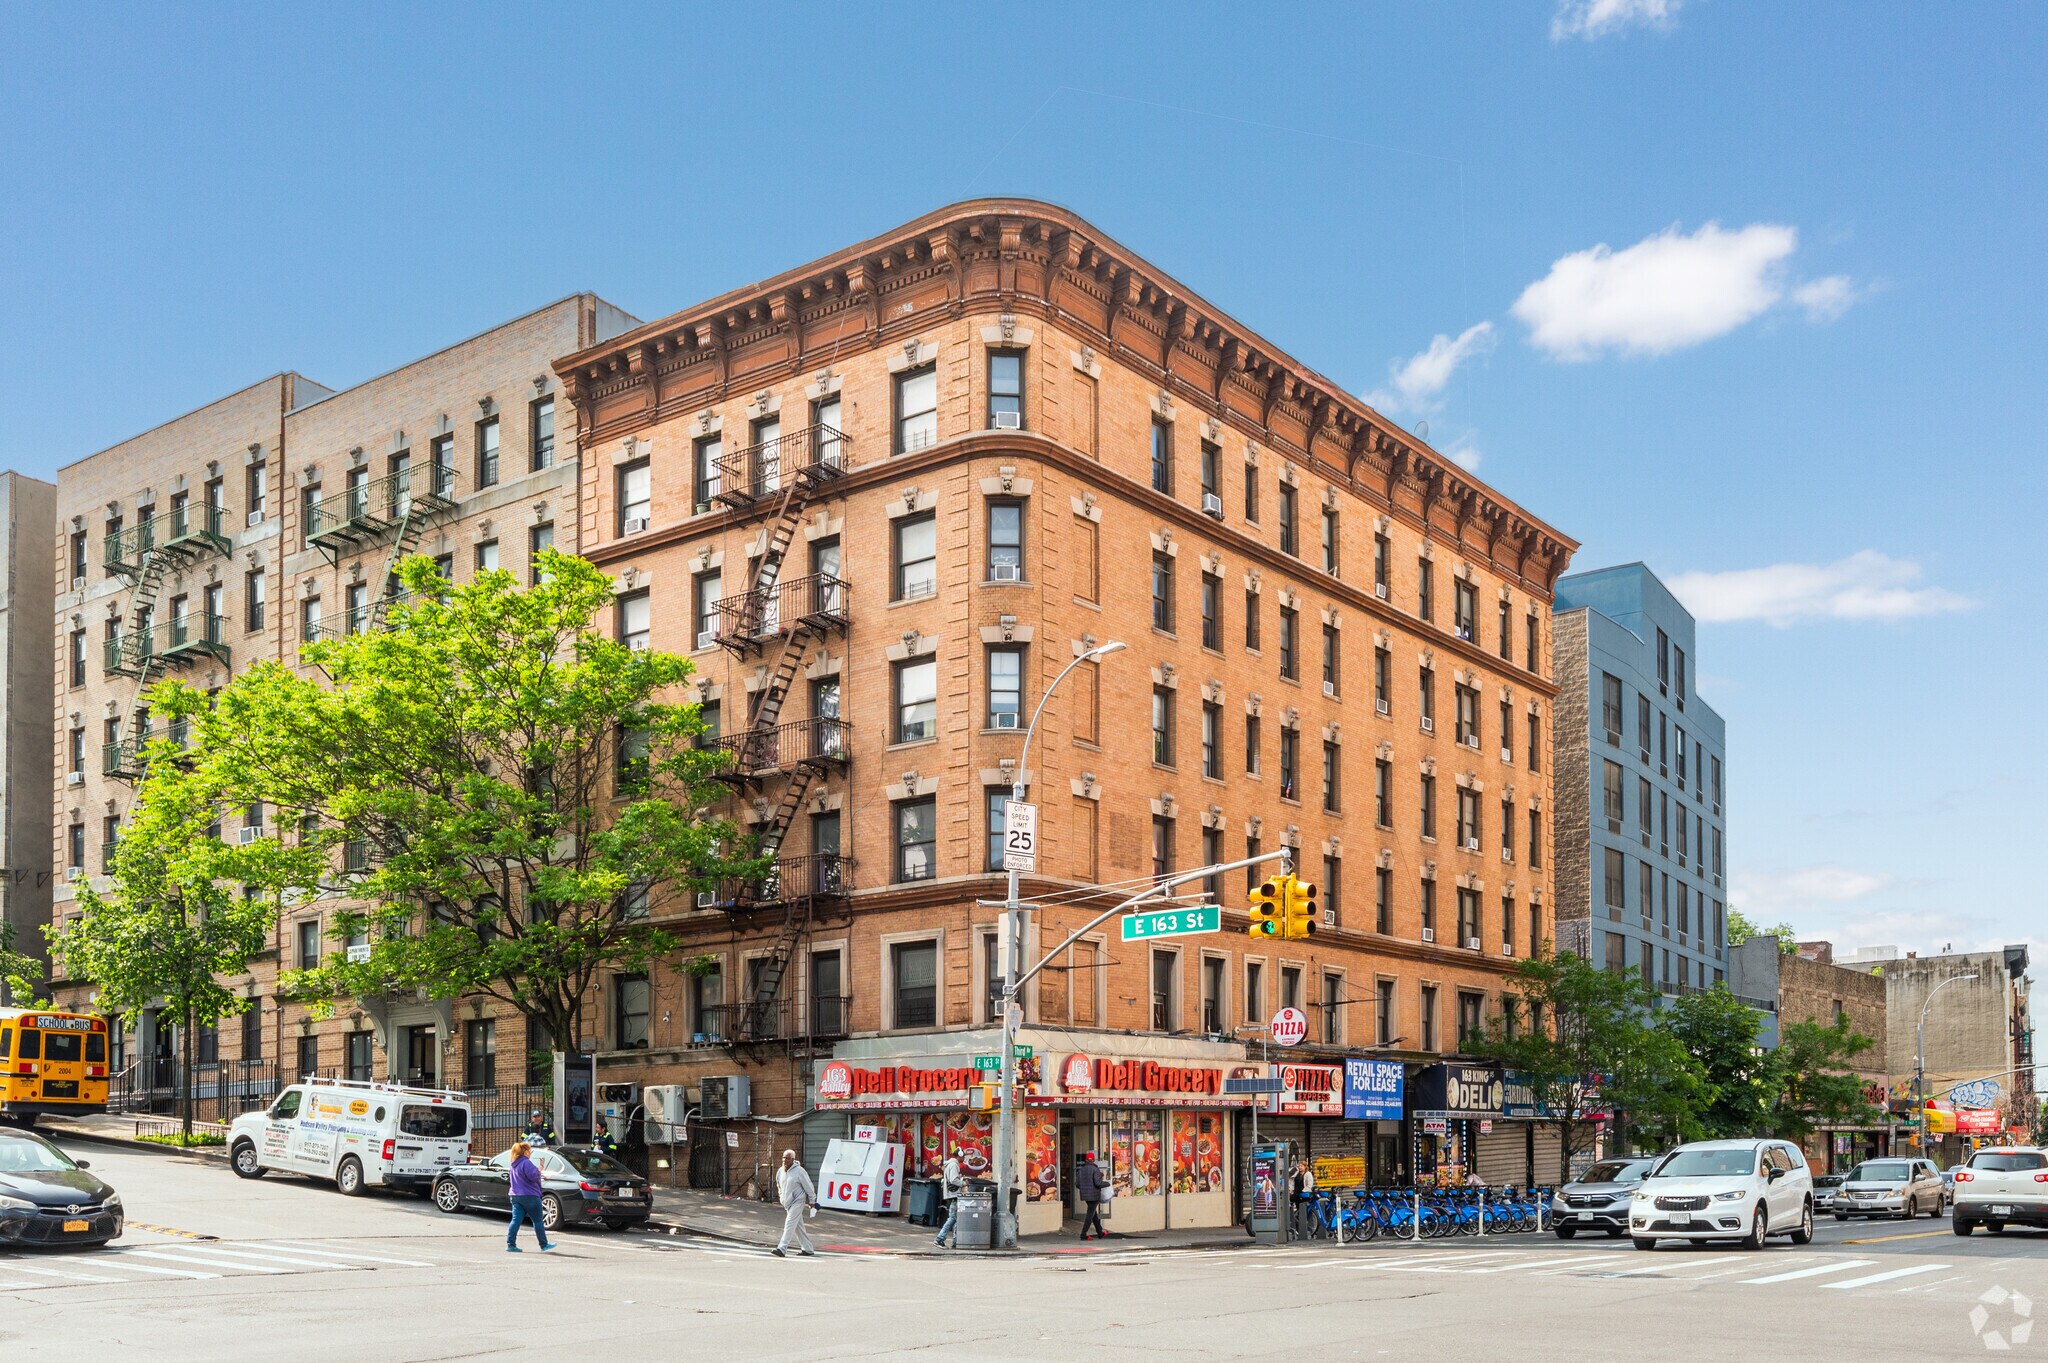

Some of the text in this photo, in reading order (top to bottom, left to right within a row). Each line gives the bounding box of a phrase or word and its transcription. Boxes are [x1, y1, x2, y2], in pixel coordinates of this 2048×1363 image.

[1012, 813, 1030, 821] SPEED
[1009, 831, 1032, 850] 25
[1135, 912, 1204, 934] E 163 St
[38, 1018, 90, 1030] SCHOOL BUS
[1273, 1022, 1304, 1035] PIZZA
[1014, 1046, 1026, 1056] Third
[977, 1058, 980, 1068] E
[983, 1058, 993, 1068] 163
[1072, 1061, 1088, 1075] 163
[1347, 1061, 1402, 1079] RETAIL SPACE
[826, 1068, 847, 1082] 163
[853, 1065, 982, 1094] Deli Grocery
[1096, 1059, 1223, 1096] Deli Grocery
[1297, 1069, 1330, 1091] PIZZA
[1462, 1070, 1472, 1082] 163
[1473, 1070, 1489, 1083] KING
[1353, 1076, 1396, 1092] FOR LEASE
[1297, 1092, 1330, 1101] EXPRESS
[1460, 1084, 1491, 1109] DELI
[1507, 1085, 1520, 1104] 3RD
[882, 1147, 895, 1208] ICE
[827, 1181, 869, 1202] ICE
